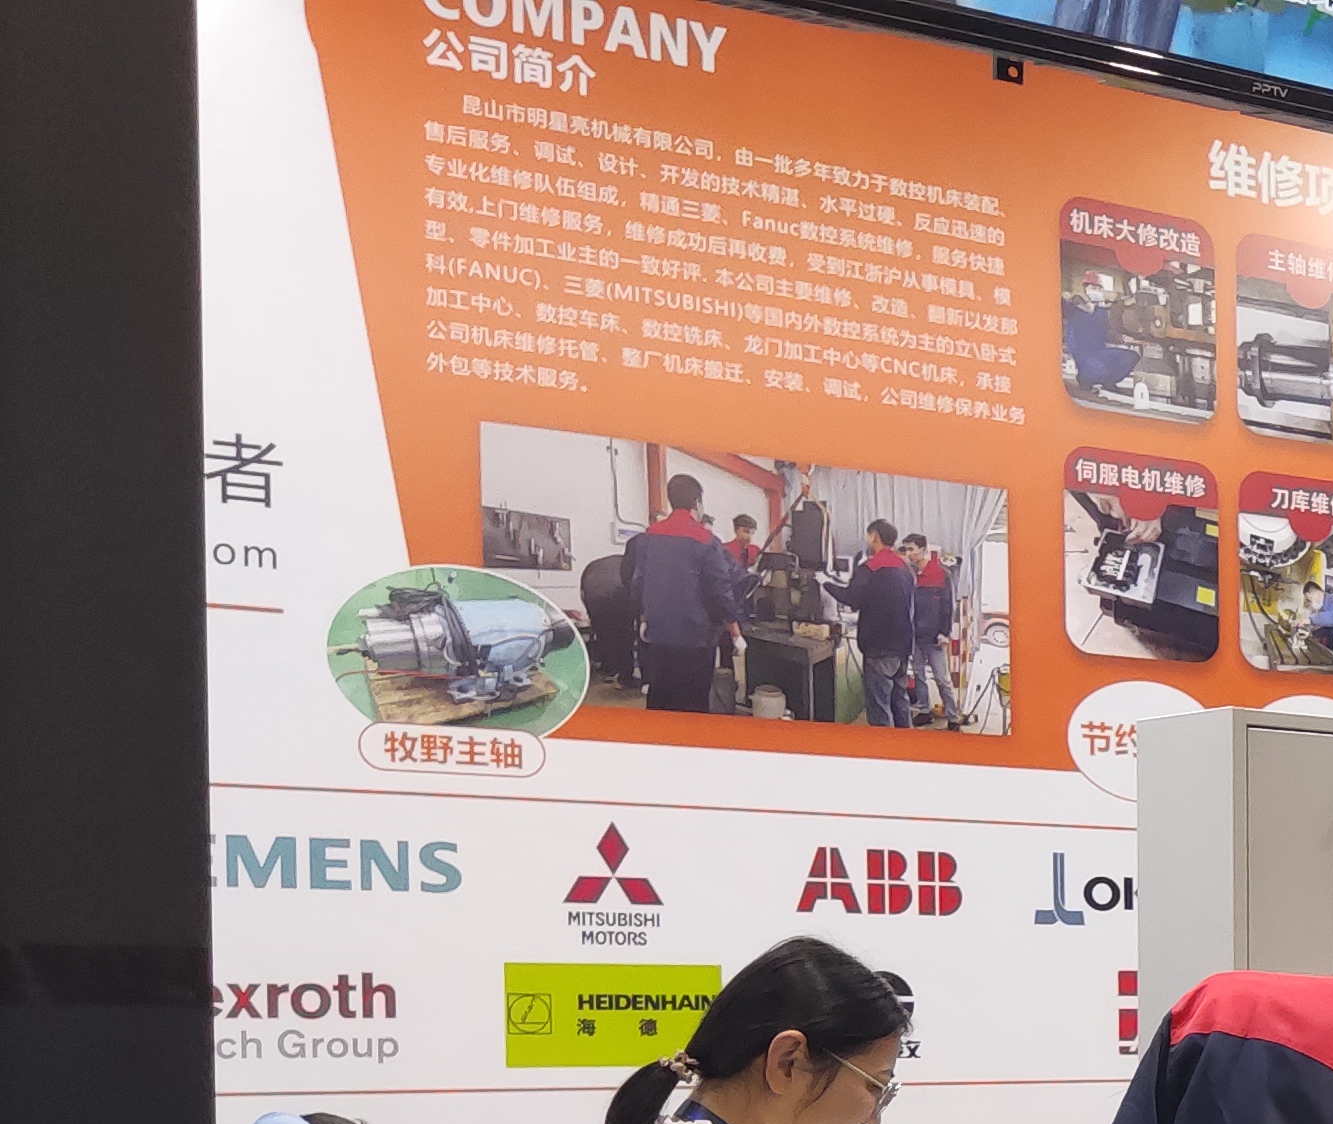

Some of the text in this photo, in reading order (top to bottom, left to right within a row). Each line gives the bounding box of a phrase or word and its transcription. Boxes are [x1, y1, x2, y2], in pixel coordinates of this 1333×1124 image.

[422, 28, 596, 96] 公司简介
[1252, 82, 1288, 98] PPTV
[1070, 208, 1202, 256] 机床大修改造
[204, 433, 283, 508] 者
[1075, 458, 1206, 498] 伺服电机维修
[213, 543, 277, 570] om
[384, 731, 522, 769] 牧野主轴
[796, 847, 963, 916] ABB
[568, 911, 660, 927] MITSUBISHI
[581, 930, 647, 946] MOTORS
[577, 994, 718, 1011] HEIDENHAIN
[217, 1029, 399, 1064] ch Group
